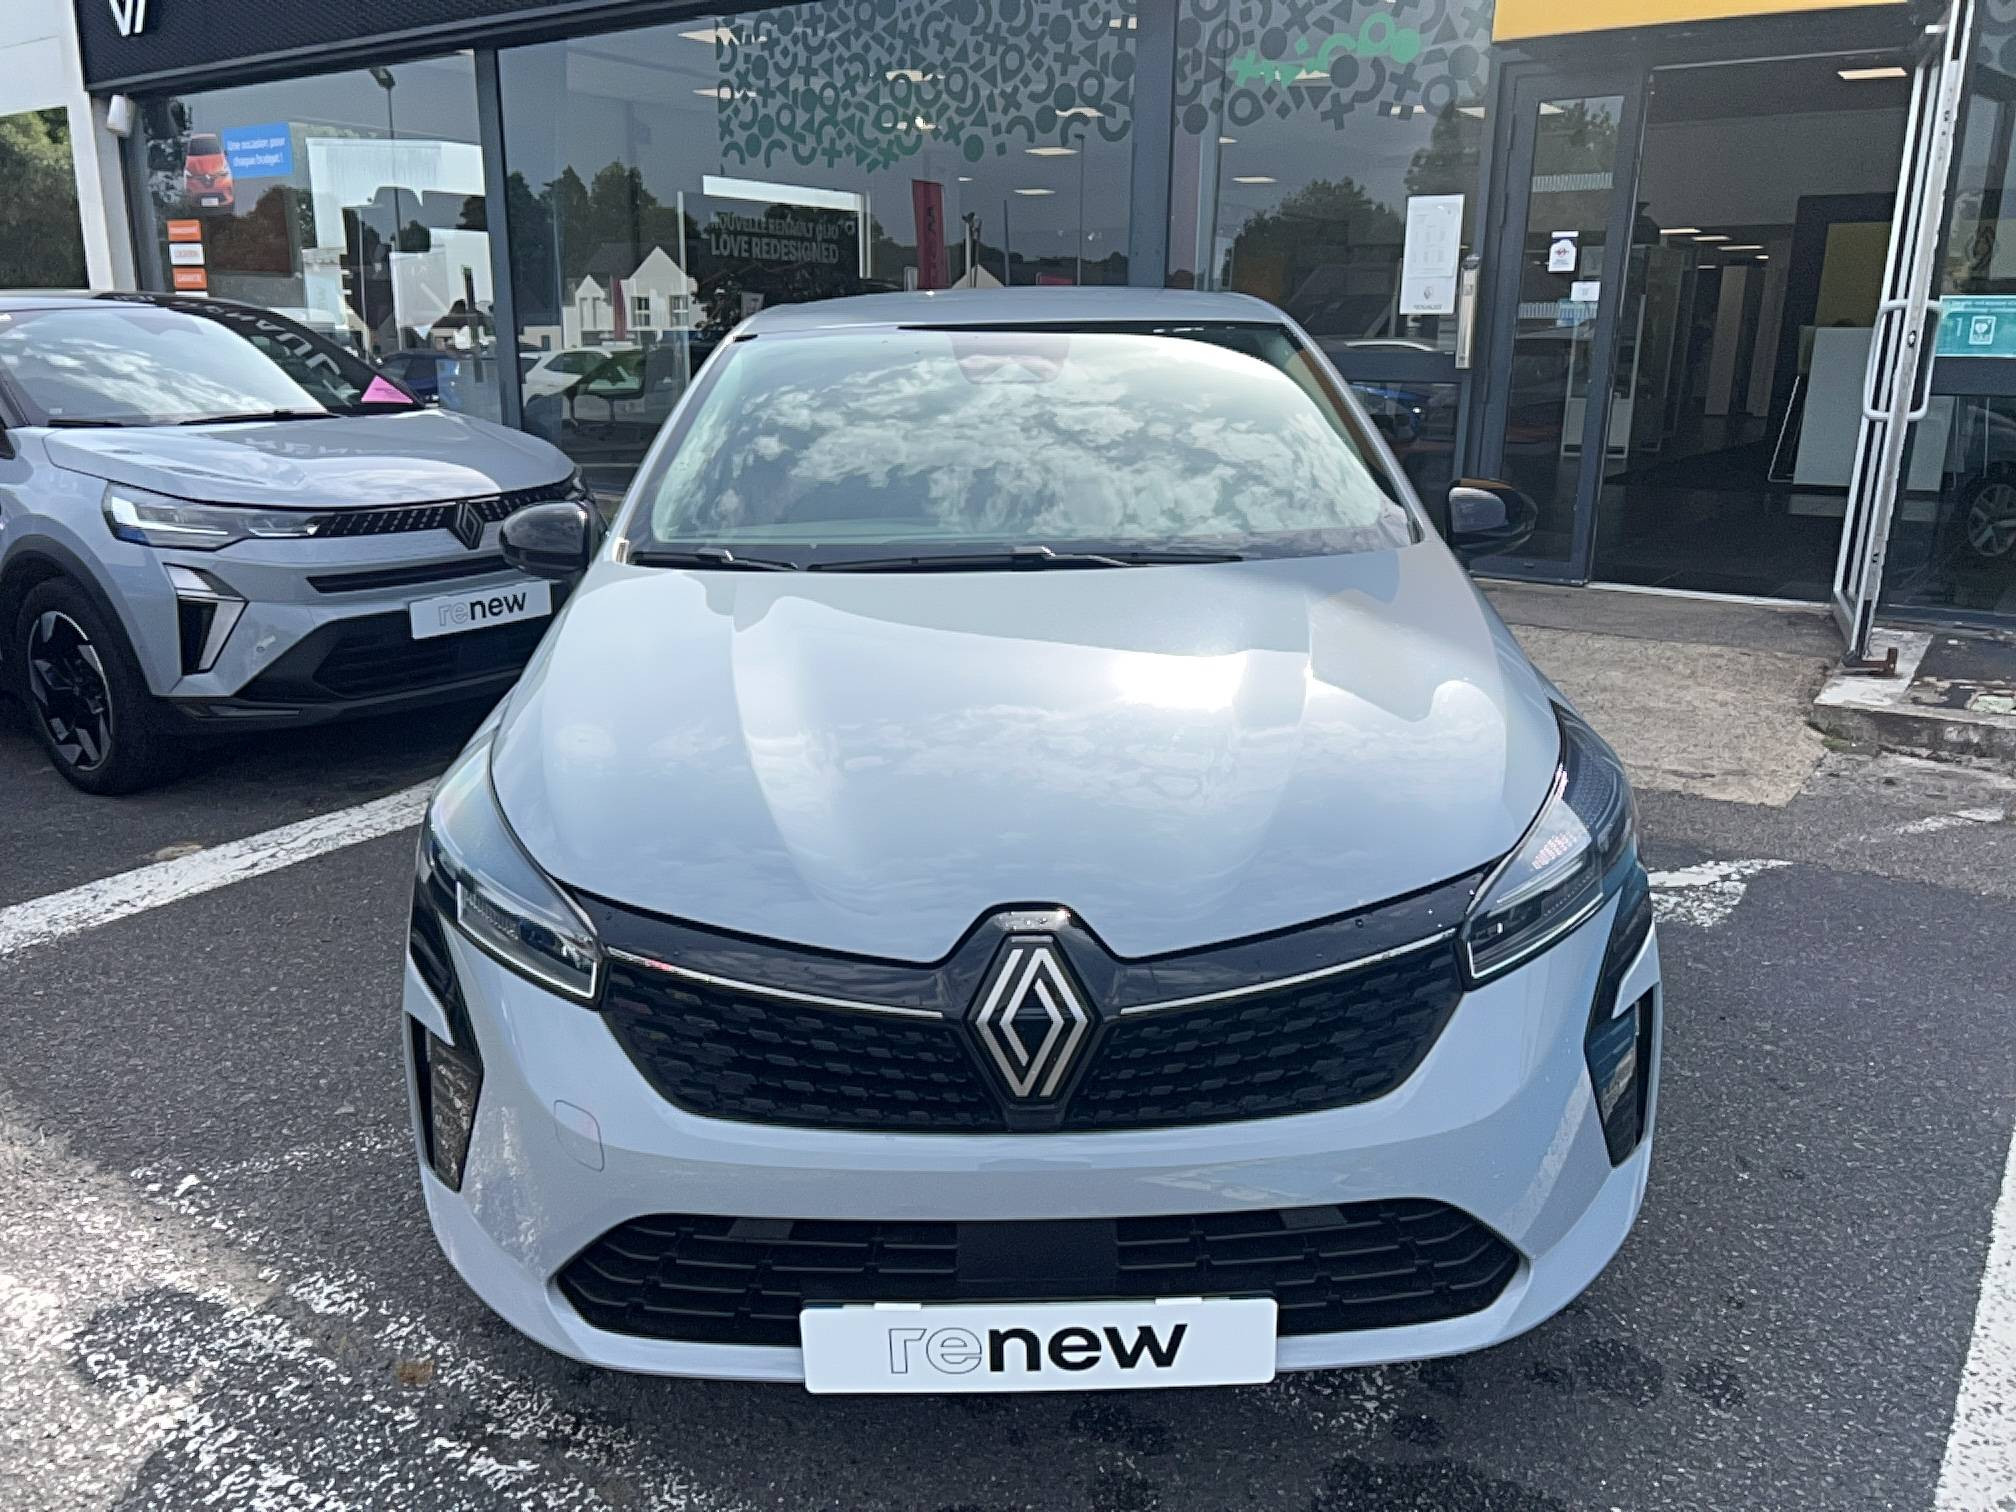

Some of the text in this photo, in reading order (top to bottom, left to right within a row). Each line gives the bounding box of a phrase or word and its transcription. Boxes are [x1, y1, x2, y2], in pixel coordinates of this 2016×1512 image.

[711, 233, 839, 264] LOVE REDESIGNED
[437, 592, 527, 627] renew
[888, 1323, 1188, 1375] renew
